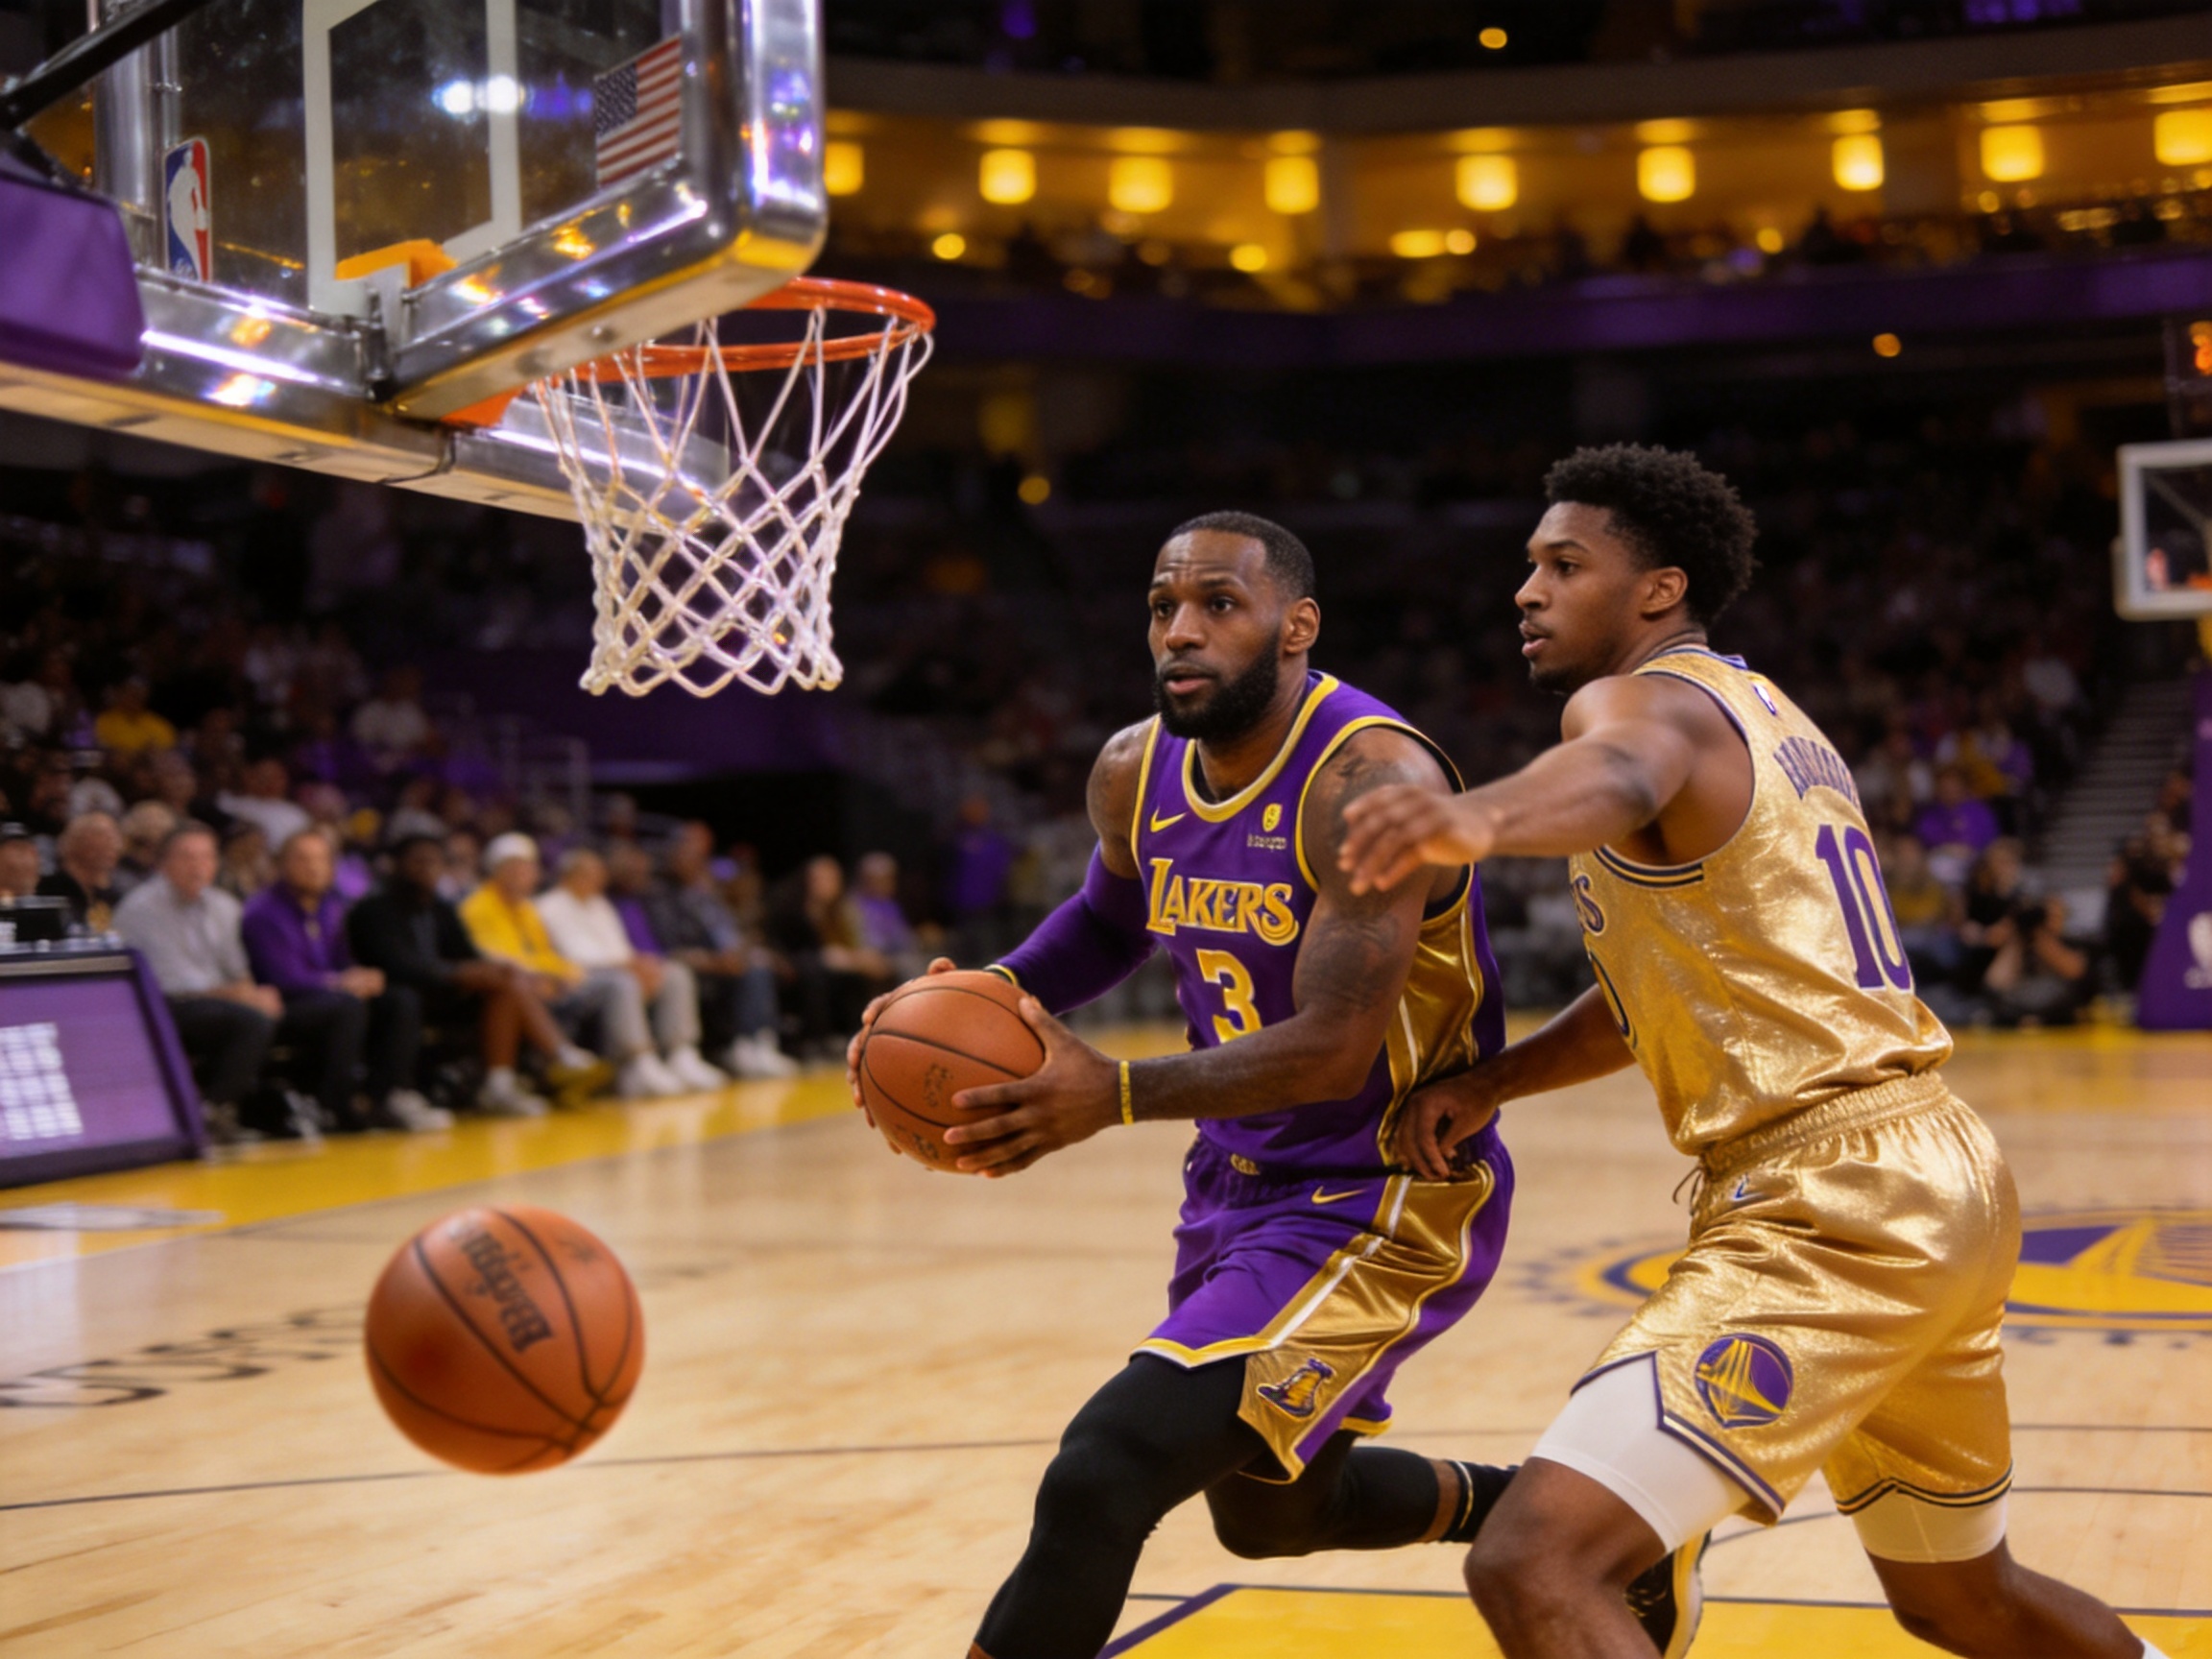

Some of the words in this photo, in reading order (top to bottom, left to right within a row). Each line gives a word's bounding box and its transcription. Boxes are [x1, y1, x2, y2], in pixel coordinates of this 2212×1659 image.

[1146, 857, 1299, 946] LAKERS
[1815, 824, 1911, 991] 10
[1196, 948, 1262, 1044] 3
